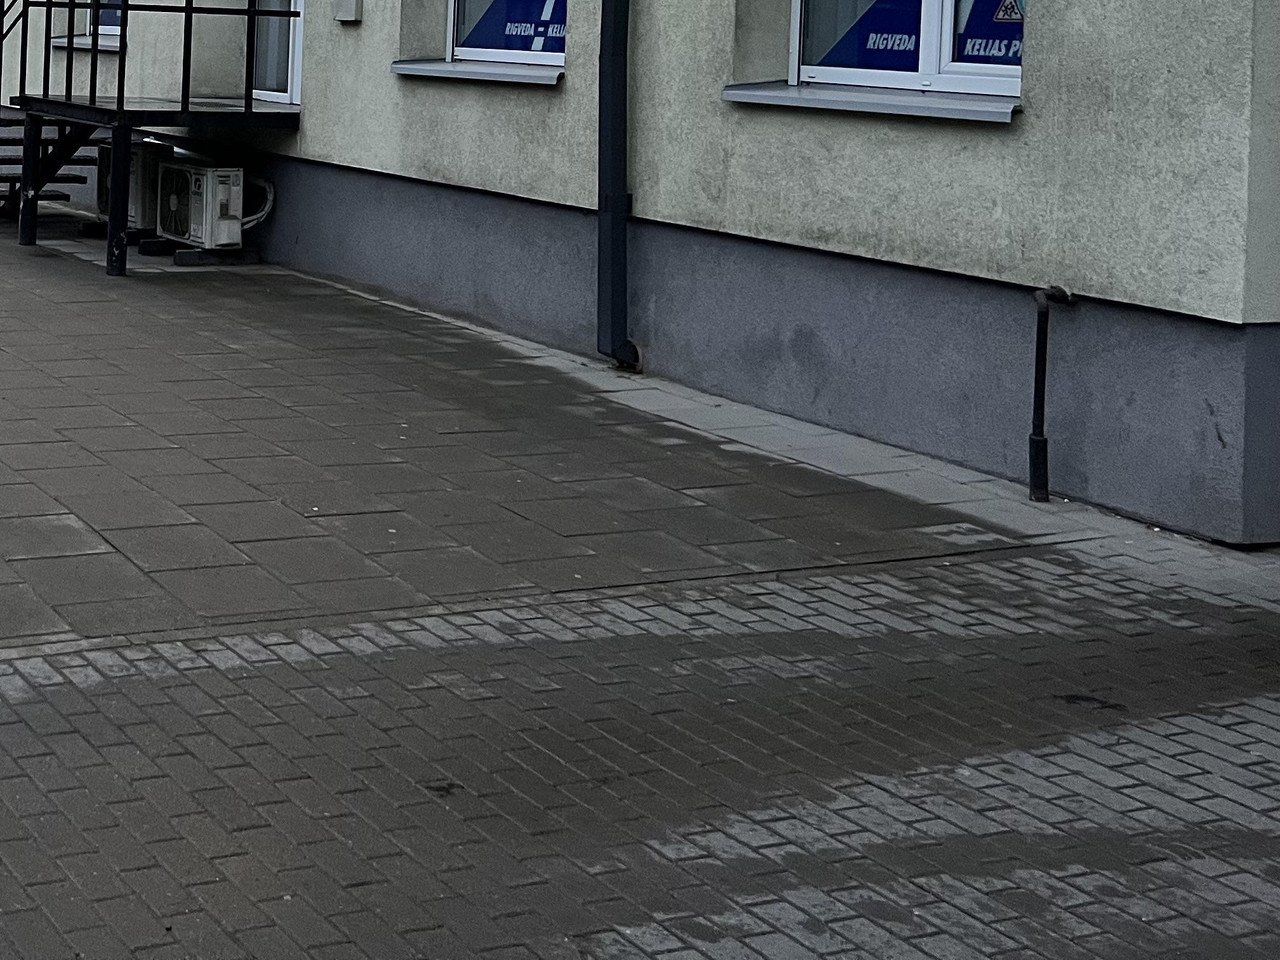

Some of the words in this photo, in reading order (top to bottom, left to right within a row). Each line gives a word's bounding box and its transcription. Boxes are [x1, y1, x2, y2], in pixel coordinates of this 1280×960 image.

[505, 22, 535, 36] RIGVEDA
[866, 32, 917, 52] RIGVEDA
[963, 38, 1008, 57] KELIAS
